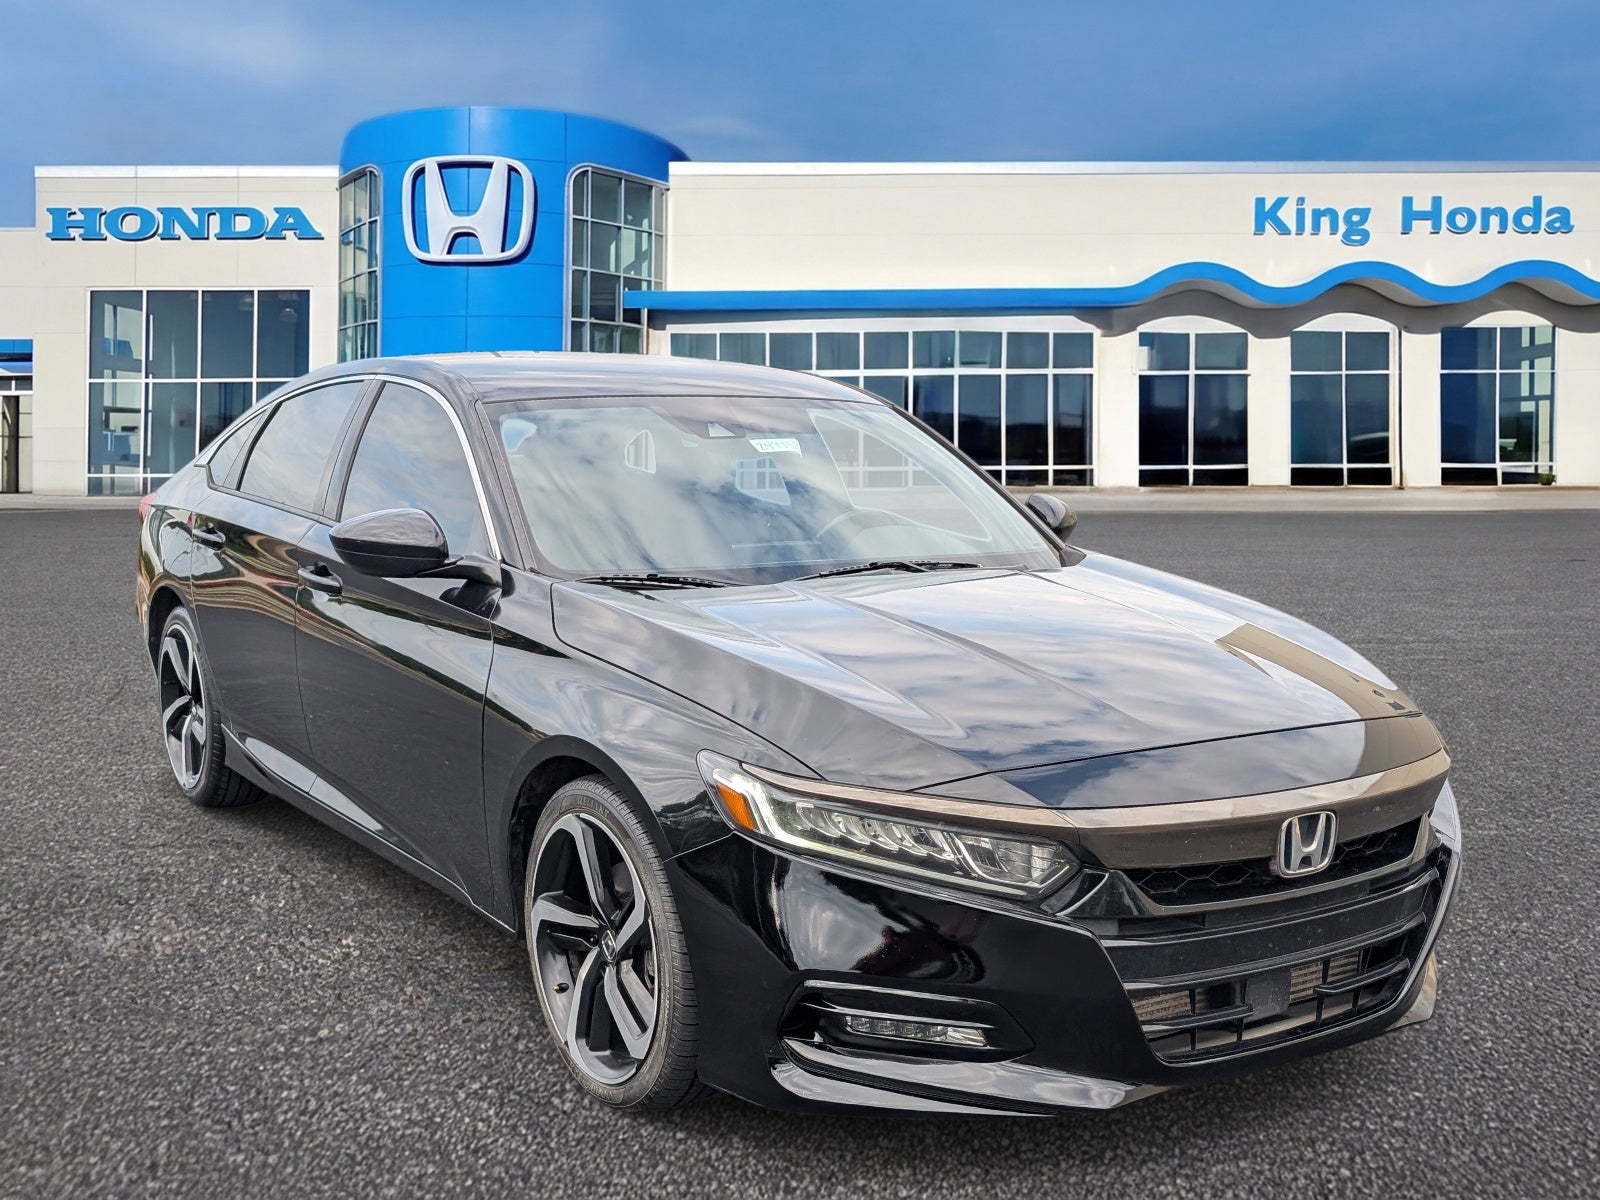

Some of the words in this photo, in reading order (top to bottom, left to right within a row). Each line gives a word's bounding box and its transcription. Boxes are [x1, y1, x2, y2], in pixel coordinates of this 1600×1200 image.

[45, 205, 324, 241] HONDA
[1254, 195, 1371, 246] King
[1401, 195, 1575, 234] Honda
